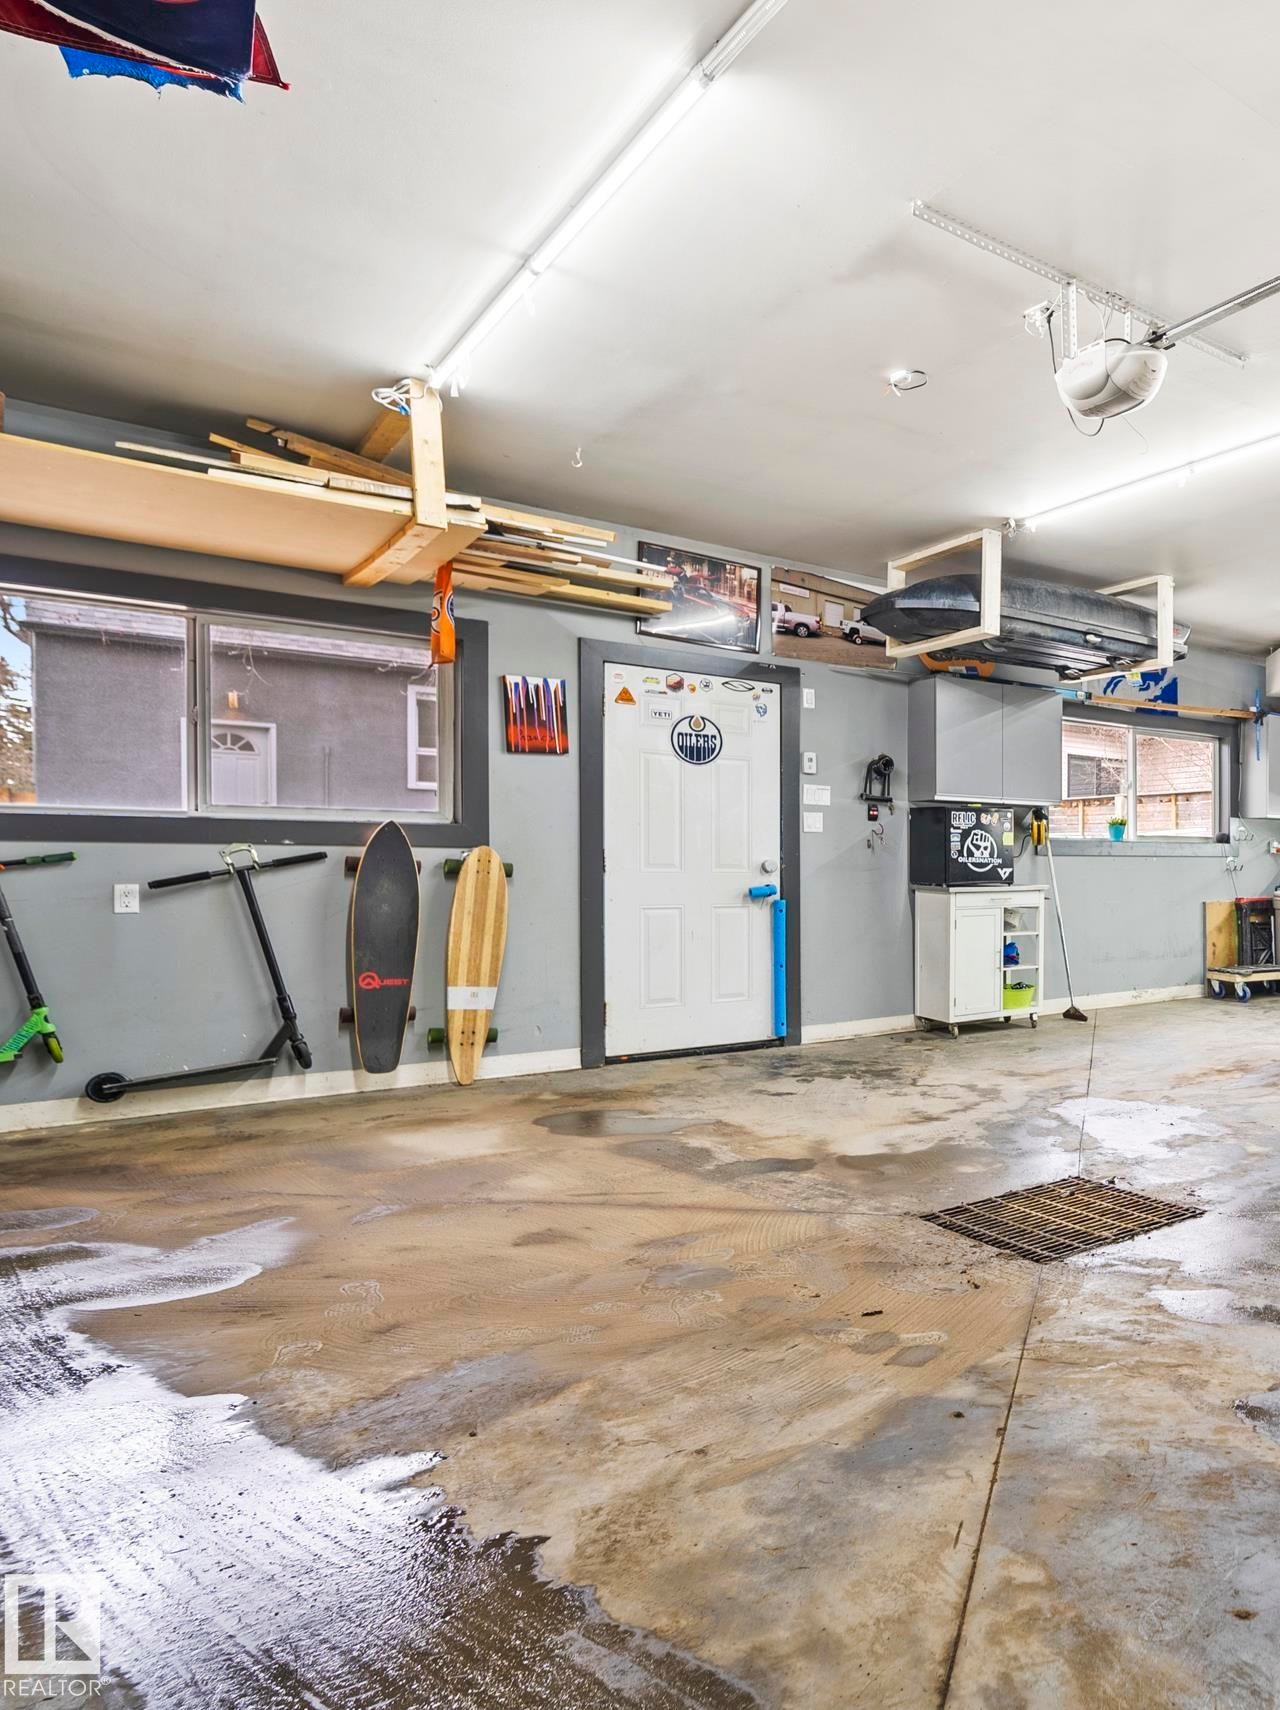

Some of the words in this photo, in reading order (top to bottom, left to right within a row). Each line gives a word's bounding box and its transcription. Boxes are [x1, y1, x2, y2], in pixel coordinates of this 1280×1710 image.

[677, 733, 717, 762] OILERS
[952, 811, 976, 824] RELIC
[958, 856, 1002, 865] OILERSNATION
